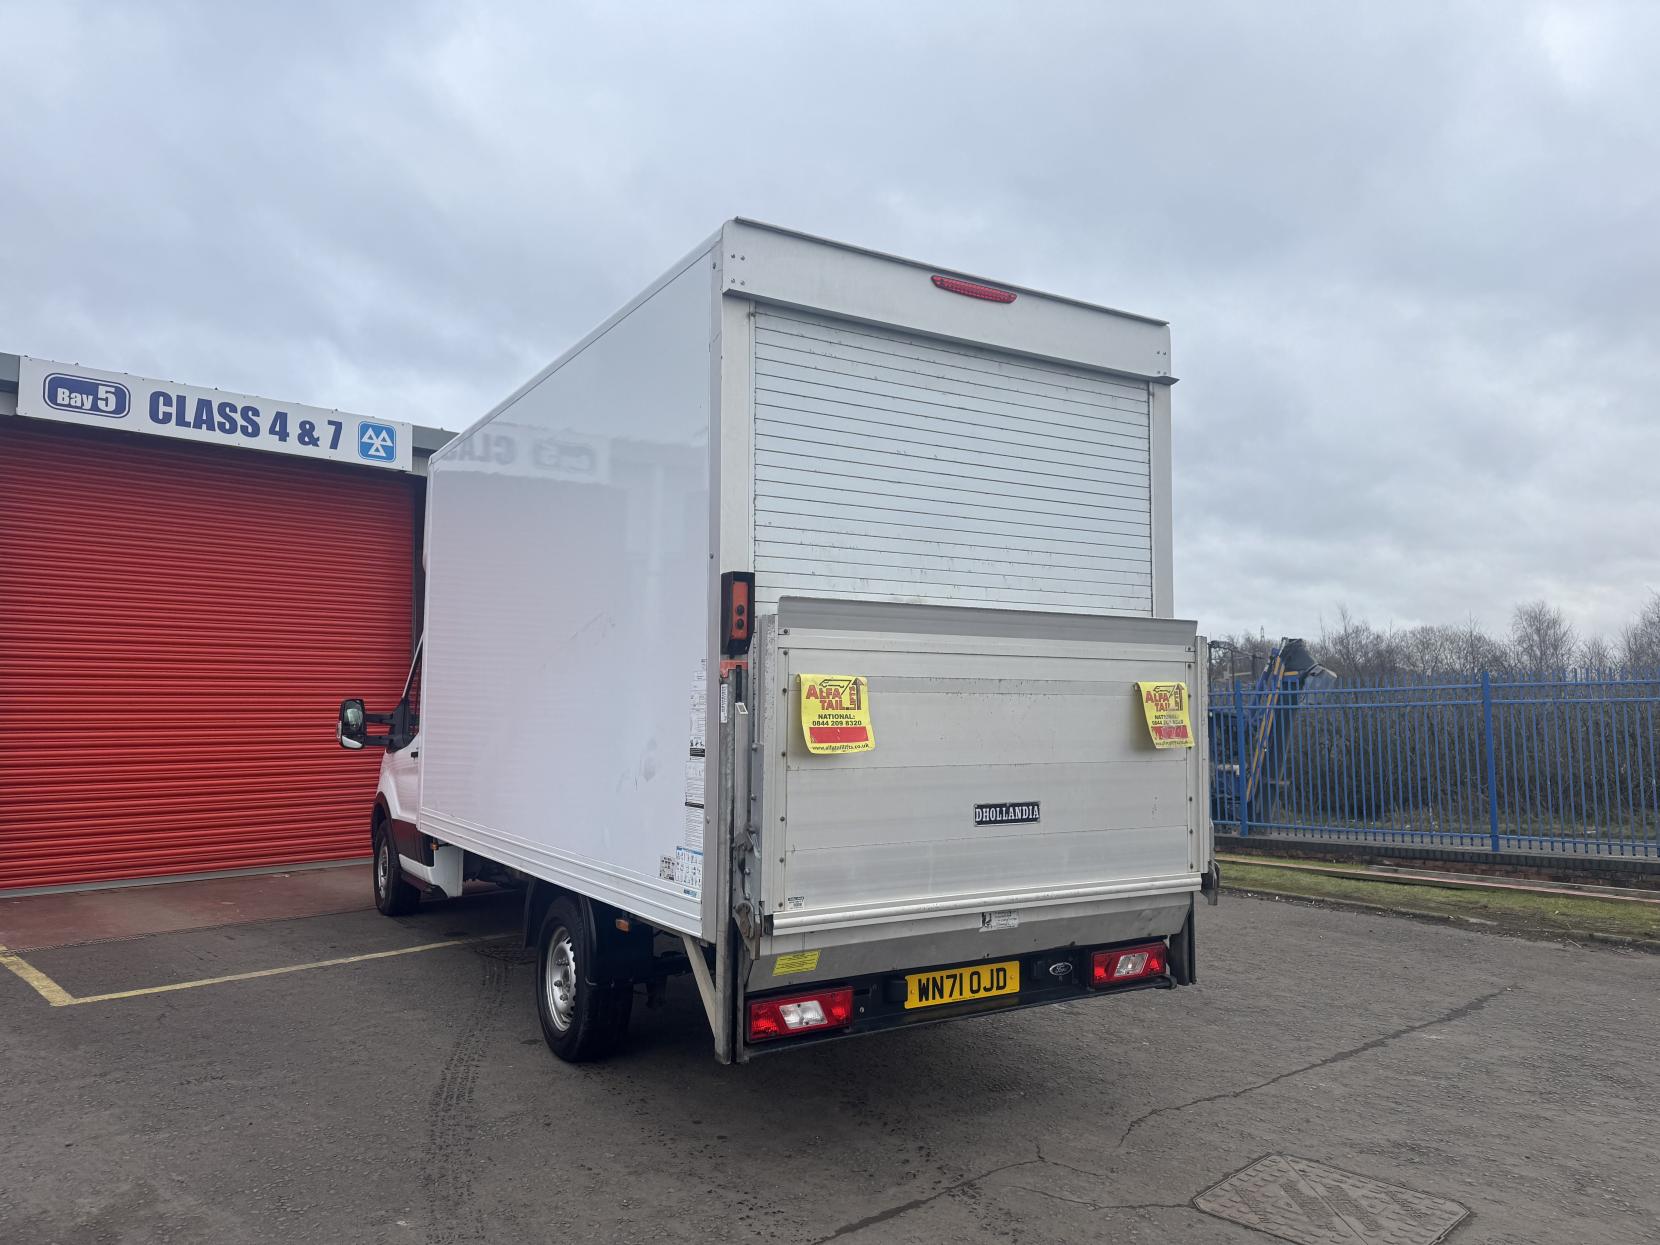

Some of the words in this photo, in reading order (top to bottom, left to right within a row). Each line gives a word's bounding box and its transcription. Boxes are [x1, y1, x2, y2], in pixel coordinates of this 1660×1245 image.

[55, 387, 94, 410] Bay
[97, 385, 117, 412] 5
[149, 390, 261, 438] CLASS
[268, 411, 289, 443] 4
[297, 420, 320, 448] &
[327, 419, 343, 450] 7
[805, 684, 842, 699] ALFA
[819, 699, 846, 710] TAIL
[975, 805, 1040, 822] DHOLLANDIA
[918, 973, 963, 1002] WN71
[969, 967, 1007, 994] OJD
